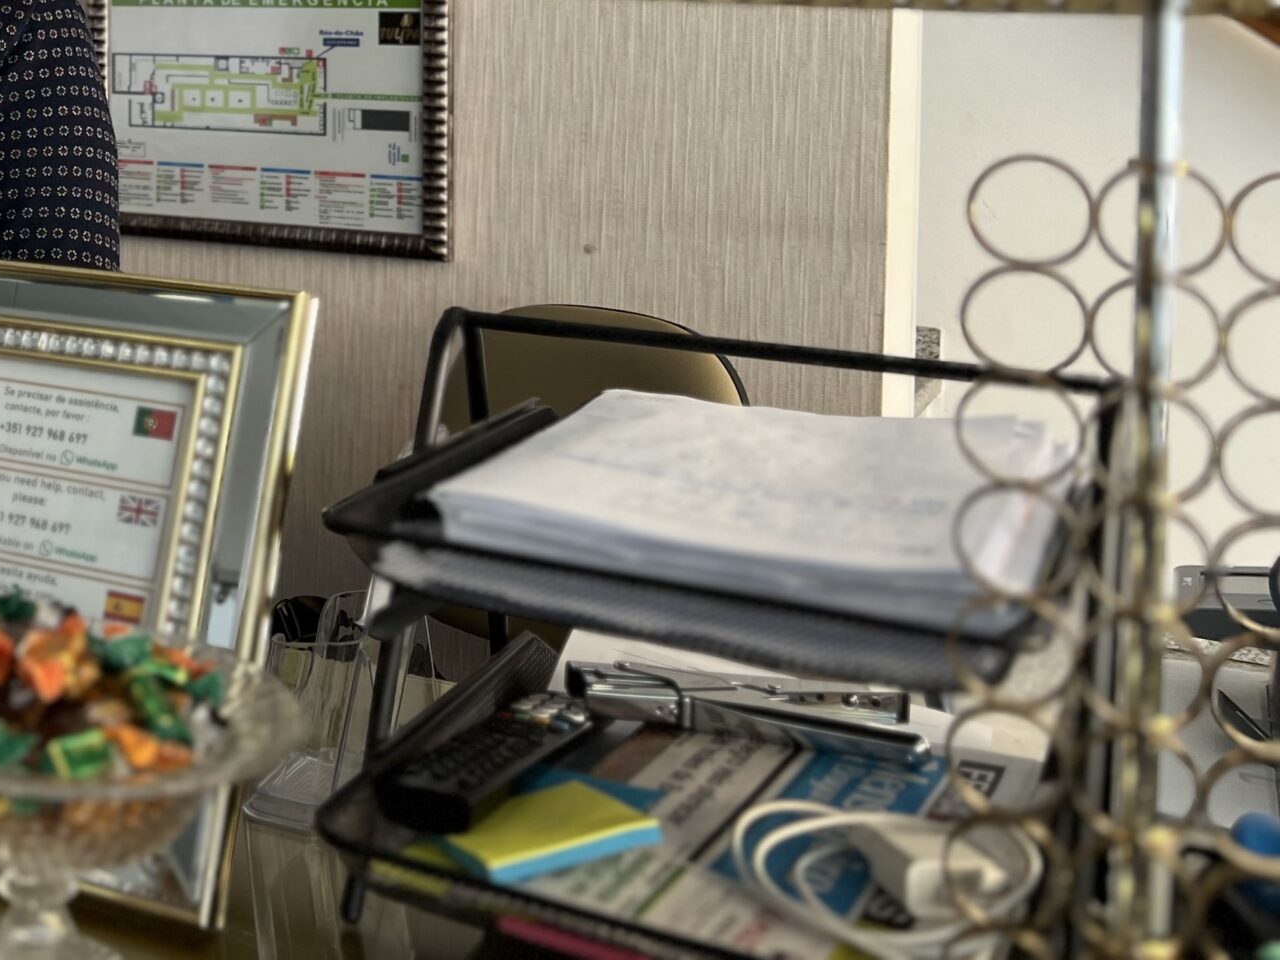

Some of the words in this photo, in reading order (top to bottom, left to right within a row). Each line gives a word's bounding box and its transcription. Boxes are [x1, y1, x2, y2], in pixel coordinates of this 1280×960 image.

[4, 386, 16, 396] Se
[17, 388, 53, 402] precisar
[55, 392, 66, 404] de
[68, 396, 119, 414] assistência,
[5, 402, 42, 417] contacte,
[45, 406, 60, 419] por
[62, 408, 84, 421] favor
[0, 421, 22, 435] +351
[25, 424, 44, 437] 927
[47, 428, 65, 442] 968
[68, 431, 88, 445] 697
[0, 443, 44, 460] Disponível
[45, 452, 57, 462] no
[75, 455, 118, 471] WhatsApp
[13, 475, 37, 488] need
[40, 478, 64, 493] help,
[66, 484, 106, 501] contact,
[7, 512, 26, 525] 927
[29, 516, 48, 531] 968
[50, 520, 71, 535] 697
[23, 541, 34, 550] on
[54, 545, 98, 562] WhatsApp
[26, 570, 58, 587] ayuda,
